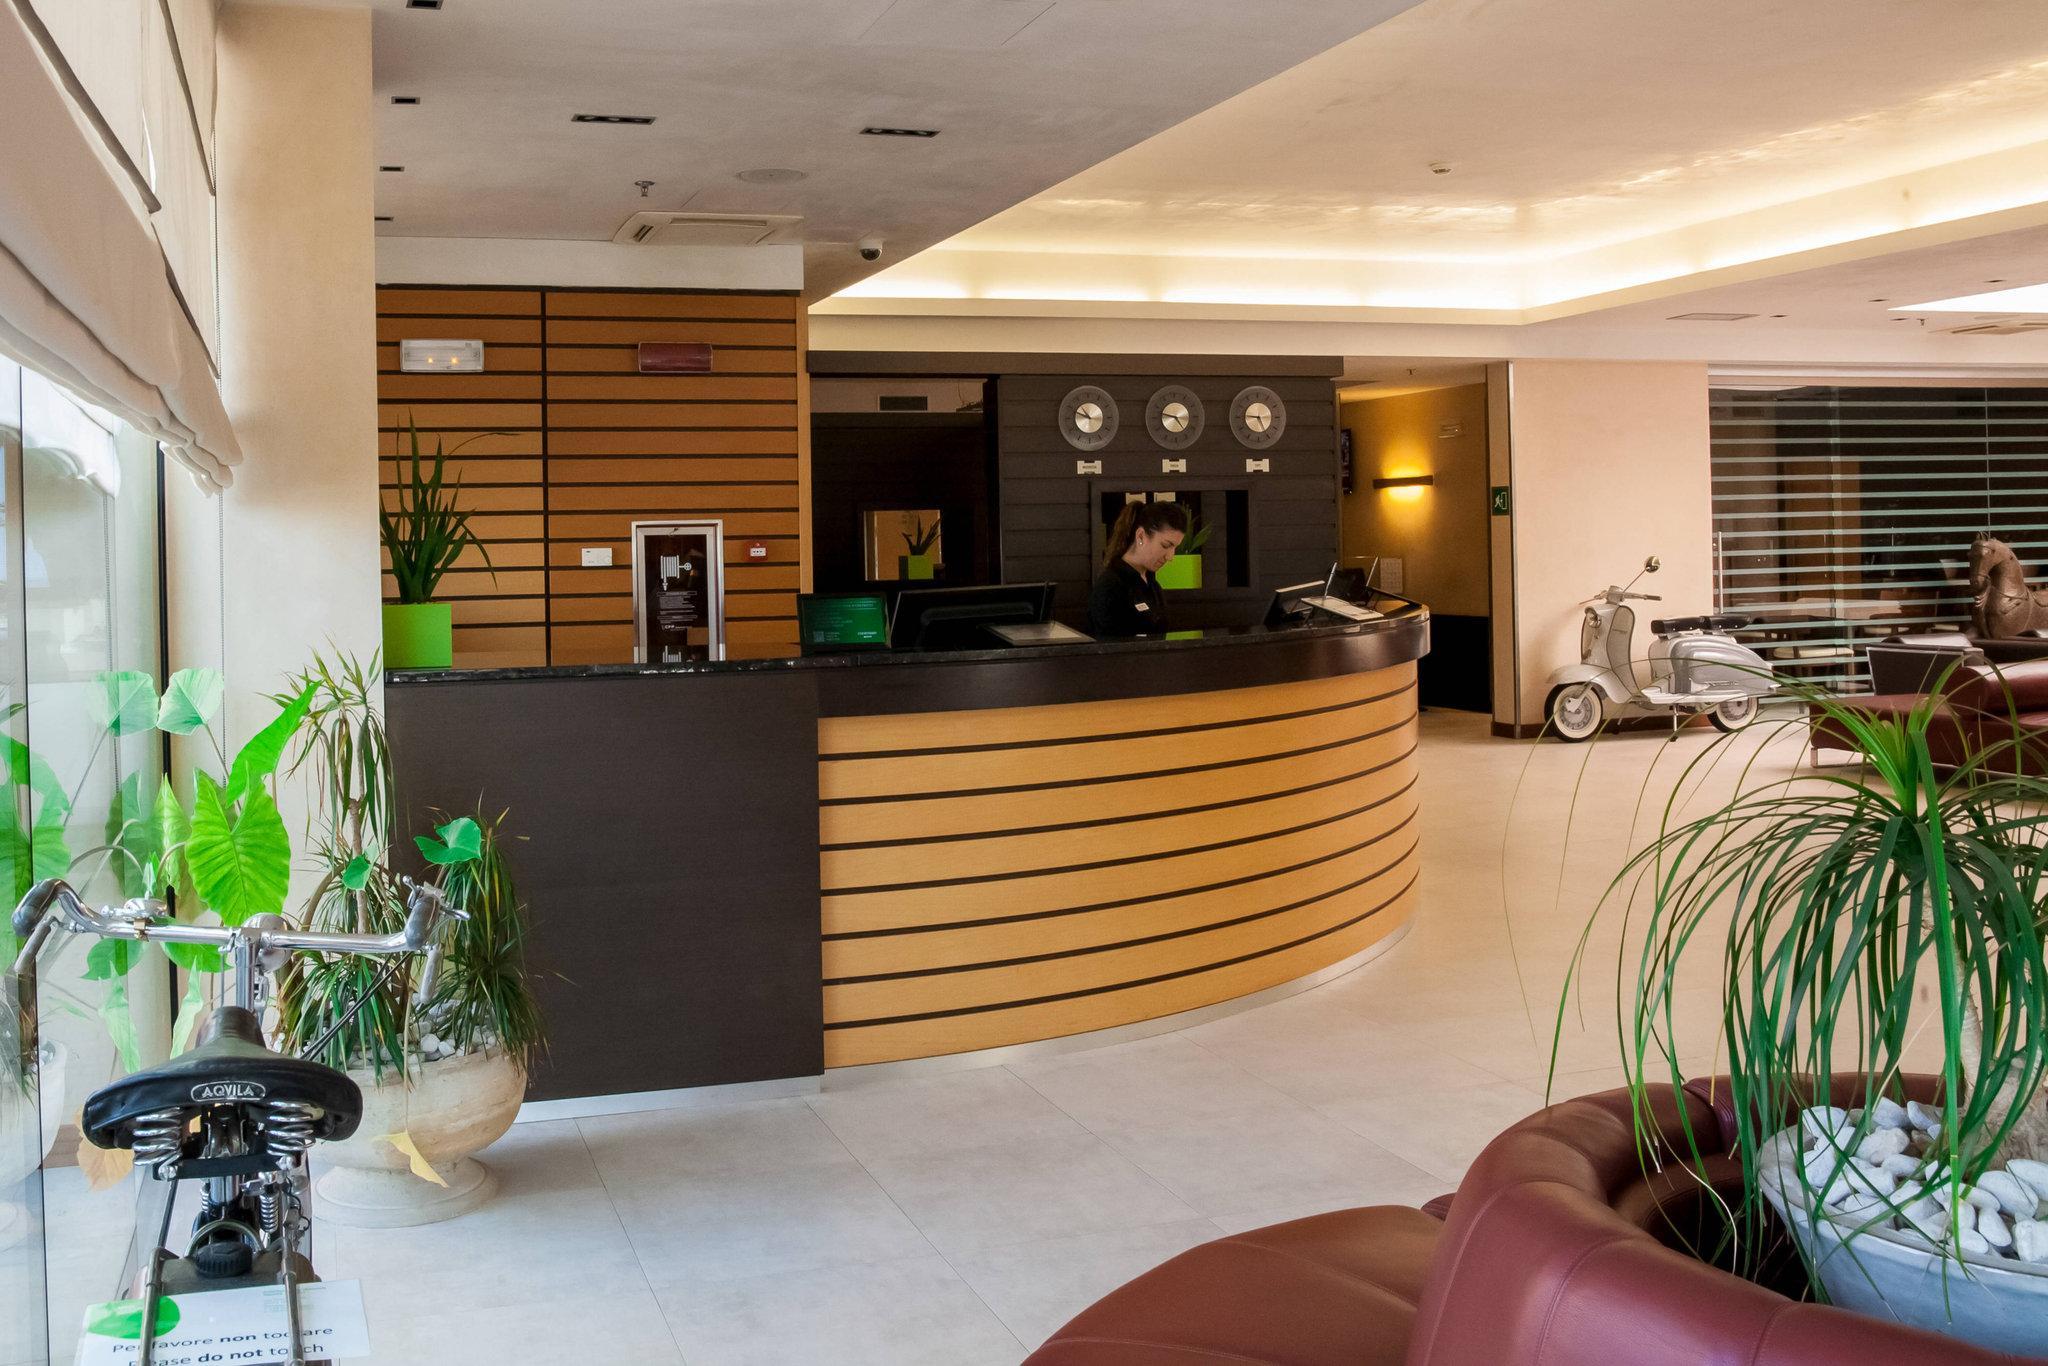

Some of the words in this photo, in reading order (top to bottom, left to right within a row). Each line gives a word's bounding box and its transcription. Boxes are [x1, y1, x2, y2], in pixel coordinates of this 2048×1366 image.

[202, 1084, 254, 1098] AQVILA
[151, 1337, 213, 1349] favore
[220, 1334, 257, 1343] non
[264, 1328, 333, 1339] tocare
[198, 1353, 223, 1363] do
[229, 1349, 263, 1360] not
[270, 1344, 324, 1355] toch
